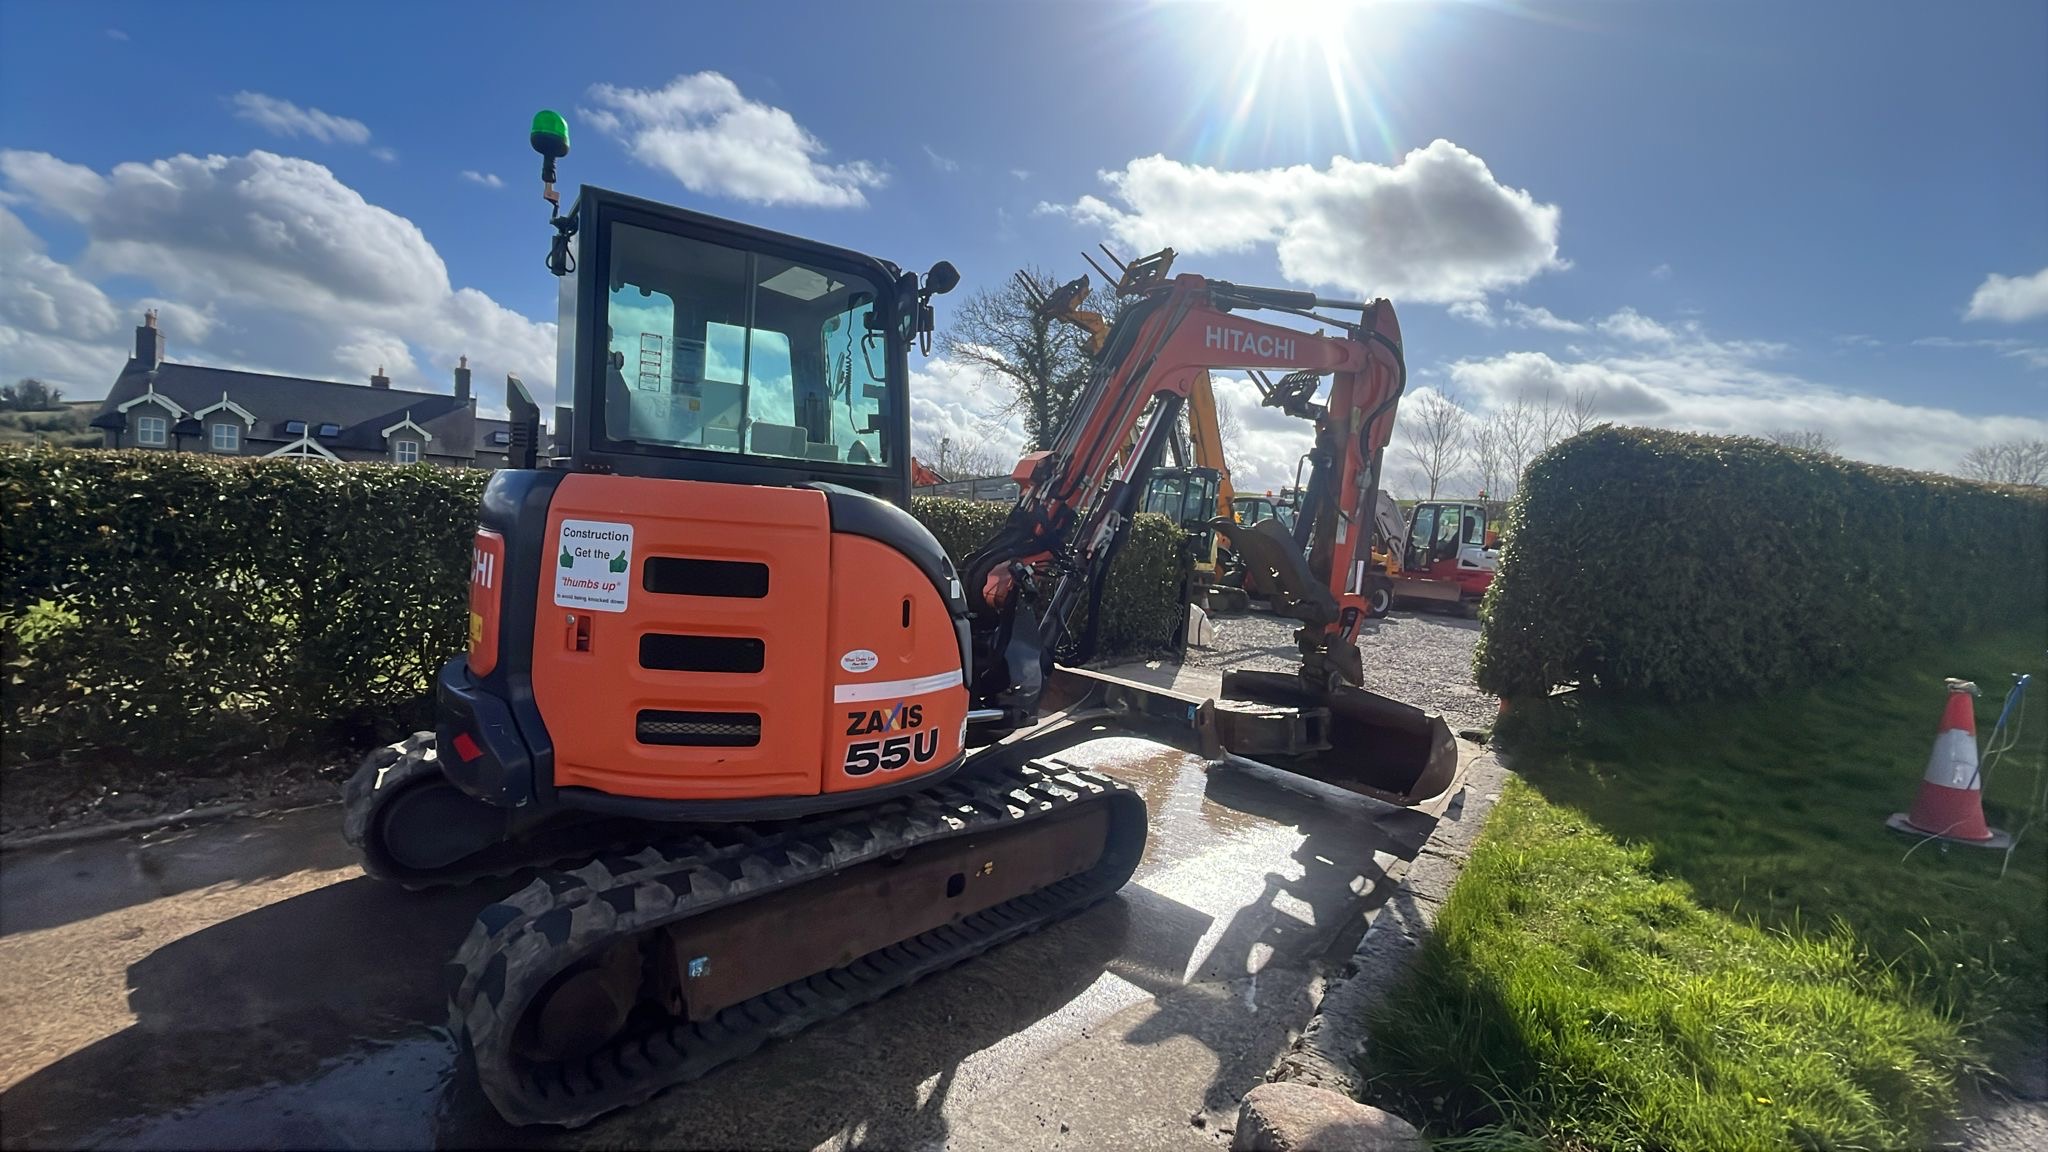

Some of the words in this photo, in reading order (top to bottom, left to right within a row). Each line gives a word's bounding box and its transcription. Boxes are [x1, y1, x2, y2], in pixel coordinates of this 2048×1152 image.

[1205, 325, 1295, 361] HITACHI
[563, 527, 629, 542] Construction
[574, 547, 592, 559] Get
[593, 548, 610, 560] the
[846, 702, 923, 736] ZAXIS
[843, 727, 939, 777] 55U
